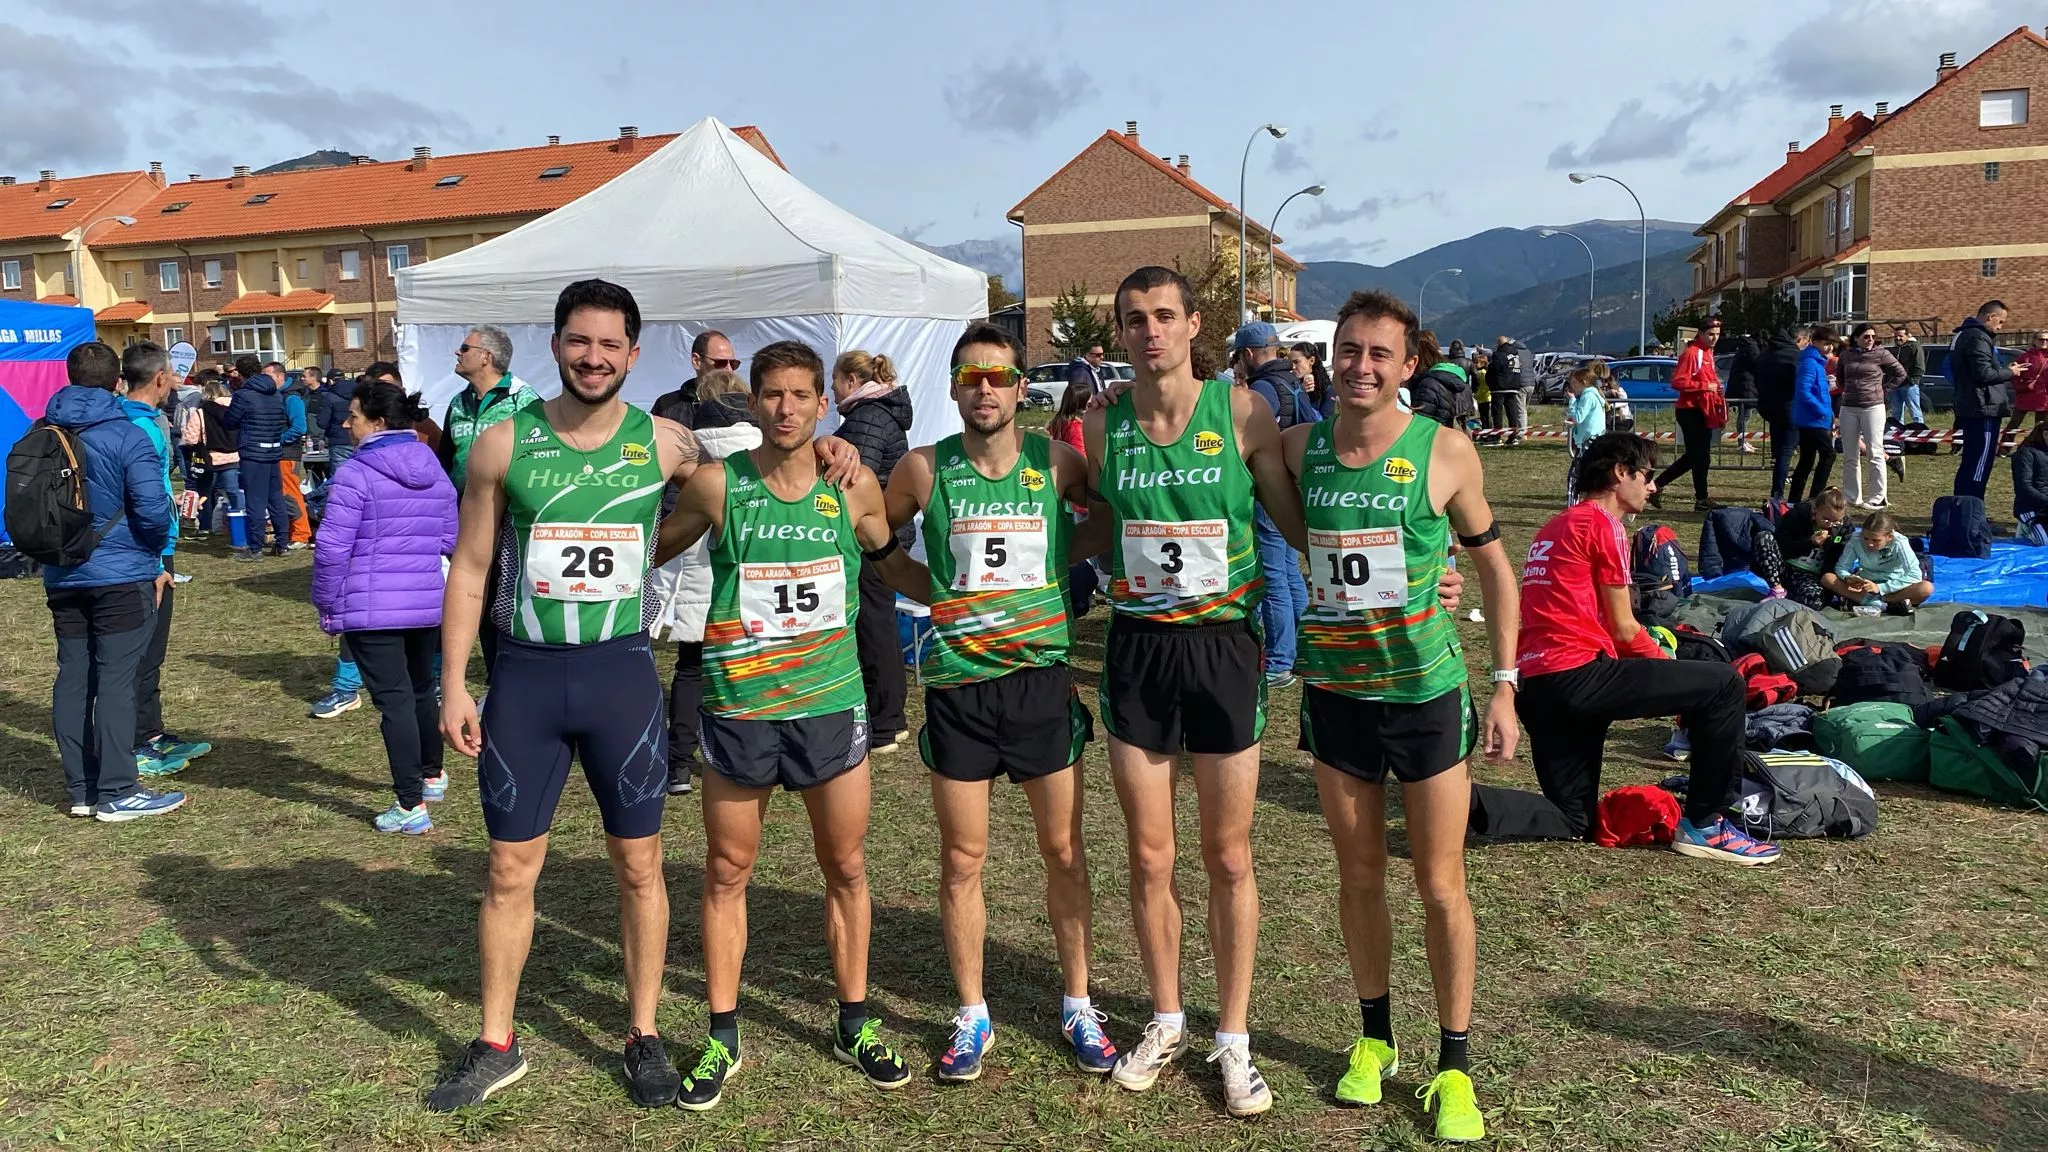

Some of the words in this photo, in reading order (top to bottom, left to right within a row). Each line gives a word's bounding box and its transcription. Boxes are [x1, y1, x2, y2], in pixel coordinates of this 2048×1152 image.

[23, 329, 62, 343] MILLAS
[527, 469, 640, 489] Huesca
[1117, 466, 1222, 491] Huesca
[949, 499, 1044, 518] Huesca
[1306, 486, 1409, 511] Huesca
[535, 529, 553, 538] COPA
[554, 528, 583, 538] ARAGÓN
[590, 530, 608, 539] COPA
[609, 530, 638, 540] ESCOLAR
[997, 522, 1014, 530] COPA
[1126, 526, 1141, 535] COPA
[1141, 525, 1167, 535] ARAGÓN
[1172, 526, 1190, 535] COPA
[1190, 526, 1222, 535] ESCOLAR
[1342, 537, 1361, 546] COPA
[1363, 534, 1396, 545] ESCOLAR
[561, 545, 614, 578] 26
[984, 537, 1007, 568] 5
[1160, 542, 1184, 574] 3
[746, 570, 764, 579] COPA
[764, 568, 792, 578] ARAGÓN
[796, 568, 811, 577] COPA
[812, 561, 839, 573] ESCOLAR
[1327, 553, 1370, 586] 10
[773, 582, 820, 614] 15
